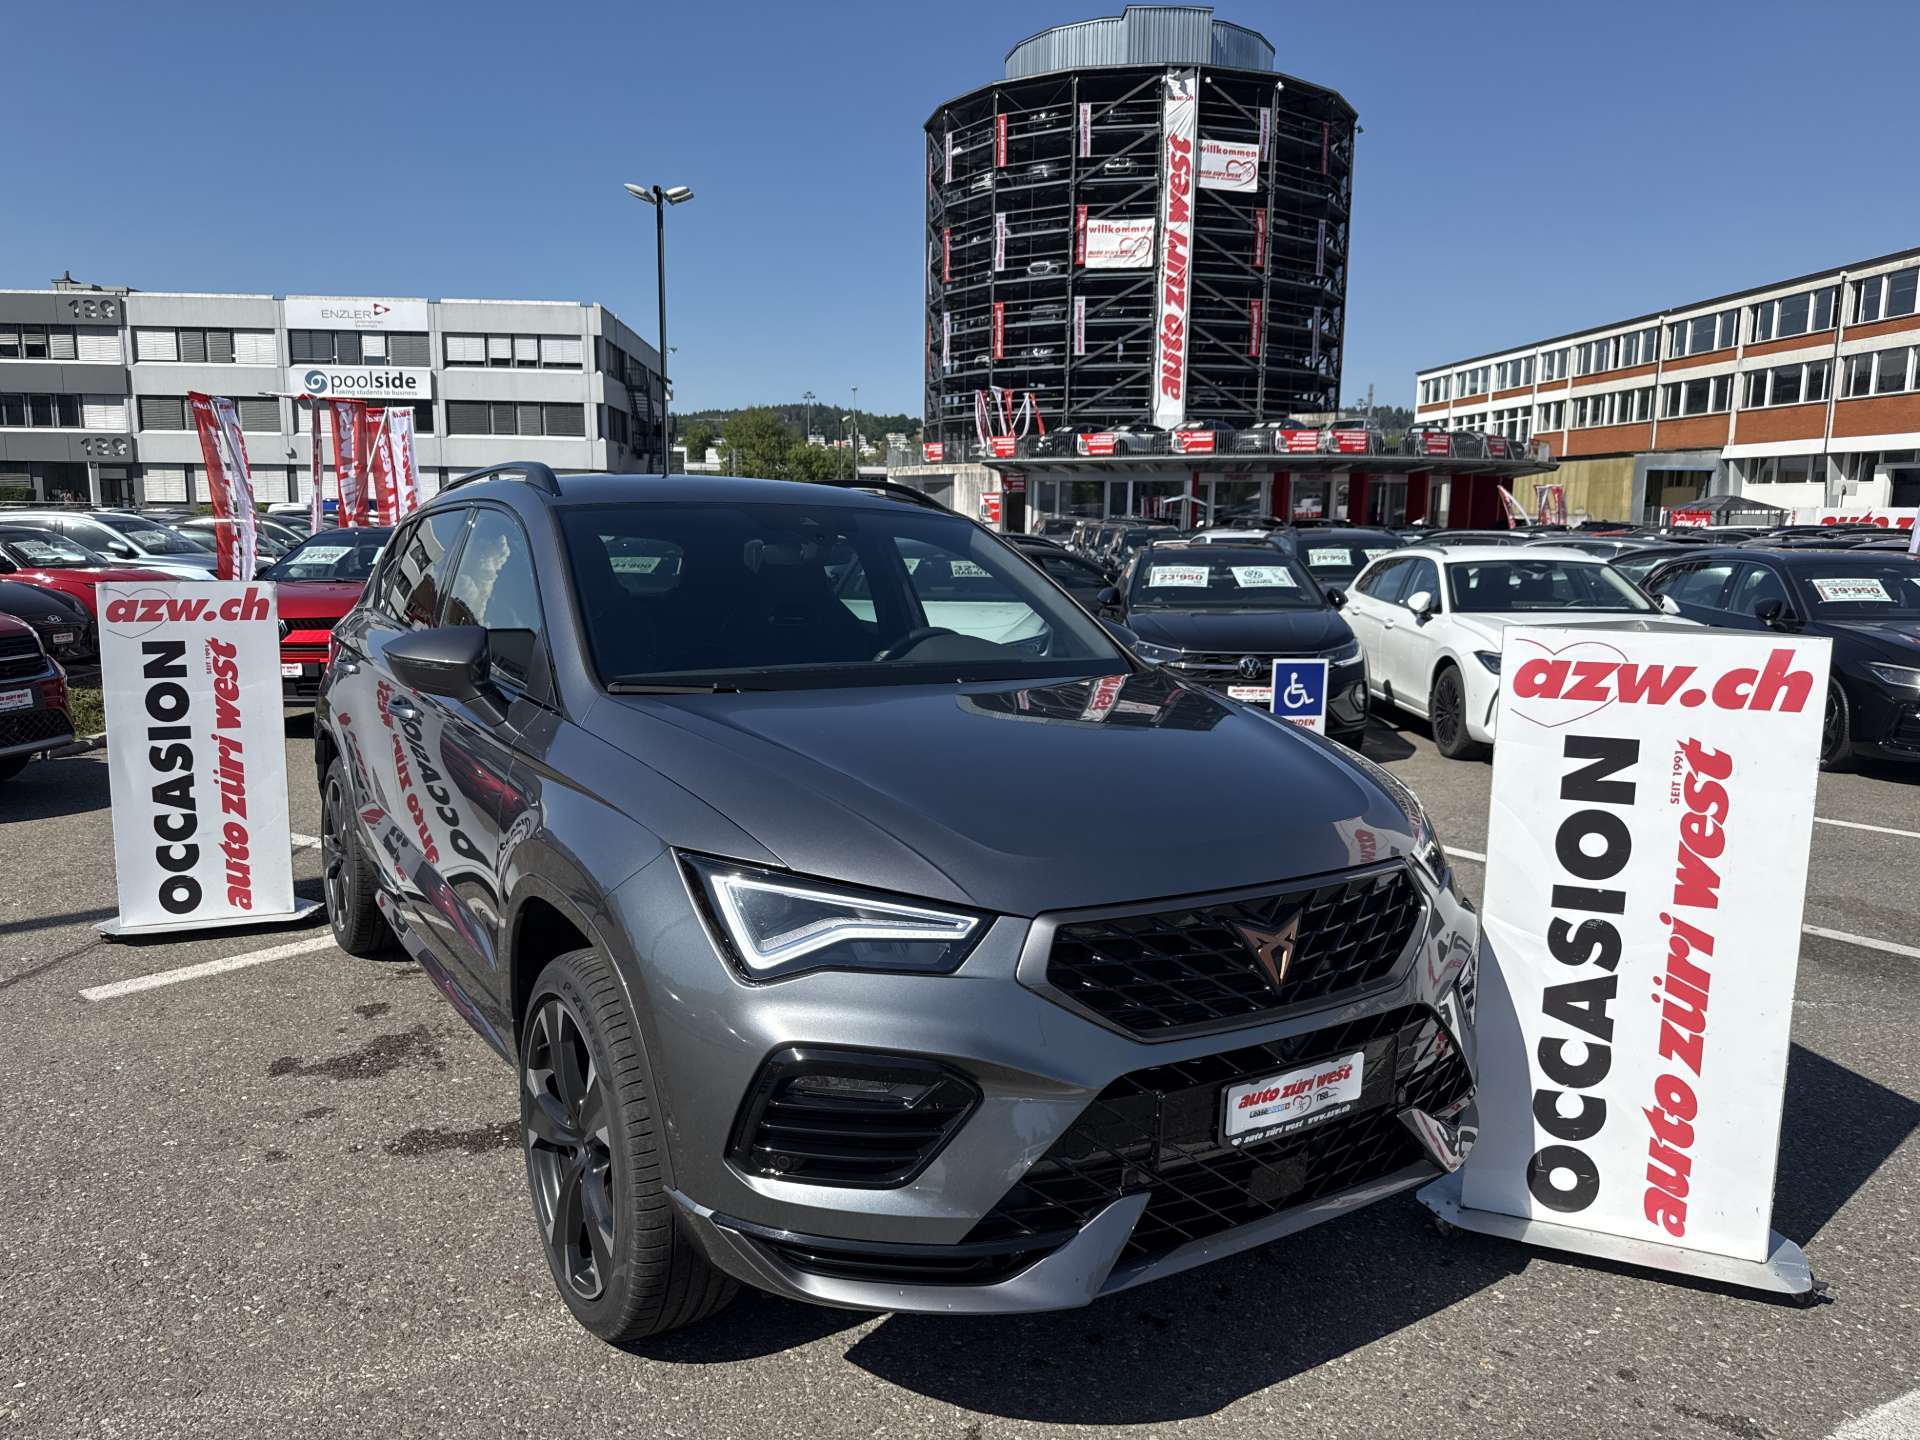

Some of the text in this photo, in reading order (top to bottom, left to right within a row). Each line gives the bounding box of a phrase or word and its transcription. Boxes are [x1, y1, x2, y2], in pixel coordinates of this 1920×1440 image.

[1199, 144, 1257, 158] willkommen
[1089, 224, 1153, 234] willkommen
[1160, 133, 1191, 400] auto züri west
[321, 309, 372, 319] ENZLER
[330, 371, 417, 394] poolside
[105, 587, 270, 623] azw.ch
[1513, 649, 1814, 713] azw.ch
[142, 641, 202, 915] OCCASION
[205, 637, 252, 910] auto züri west
[1670, 750, 1683, 804] SEIT 1991
[1526, 734, 1640, 1213] OCCASION
[1642, 737, 1733, 1238] auto züri west
[1238, 1064, 1352, 1108] auto züri west
[1244, 1104, 1351, 1143] auto züri west www.azw.ch
